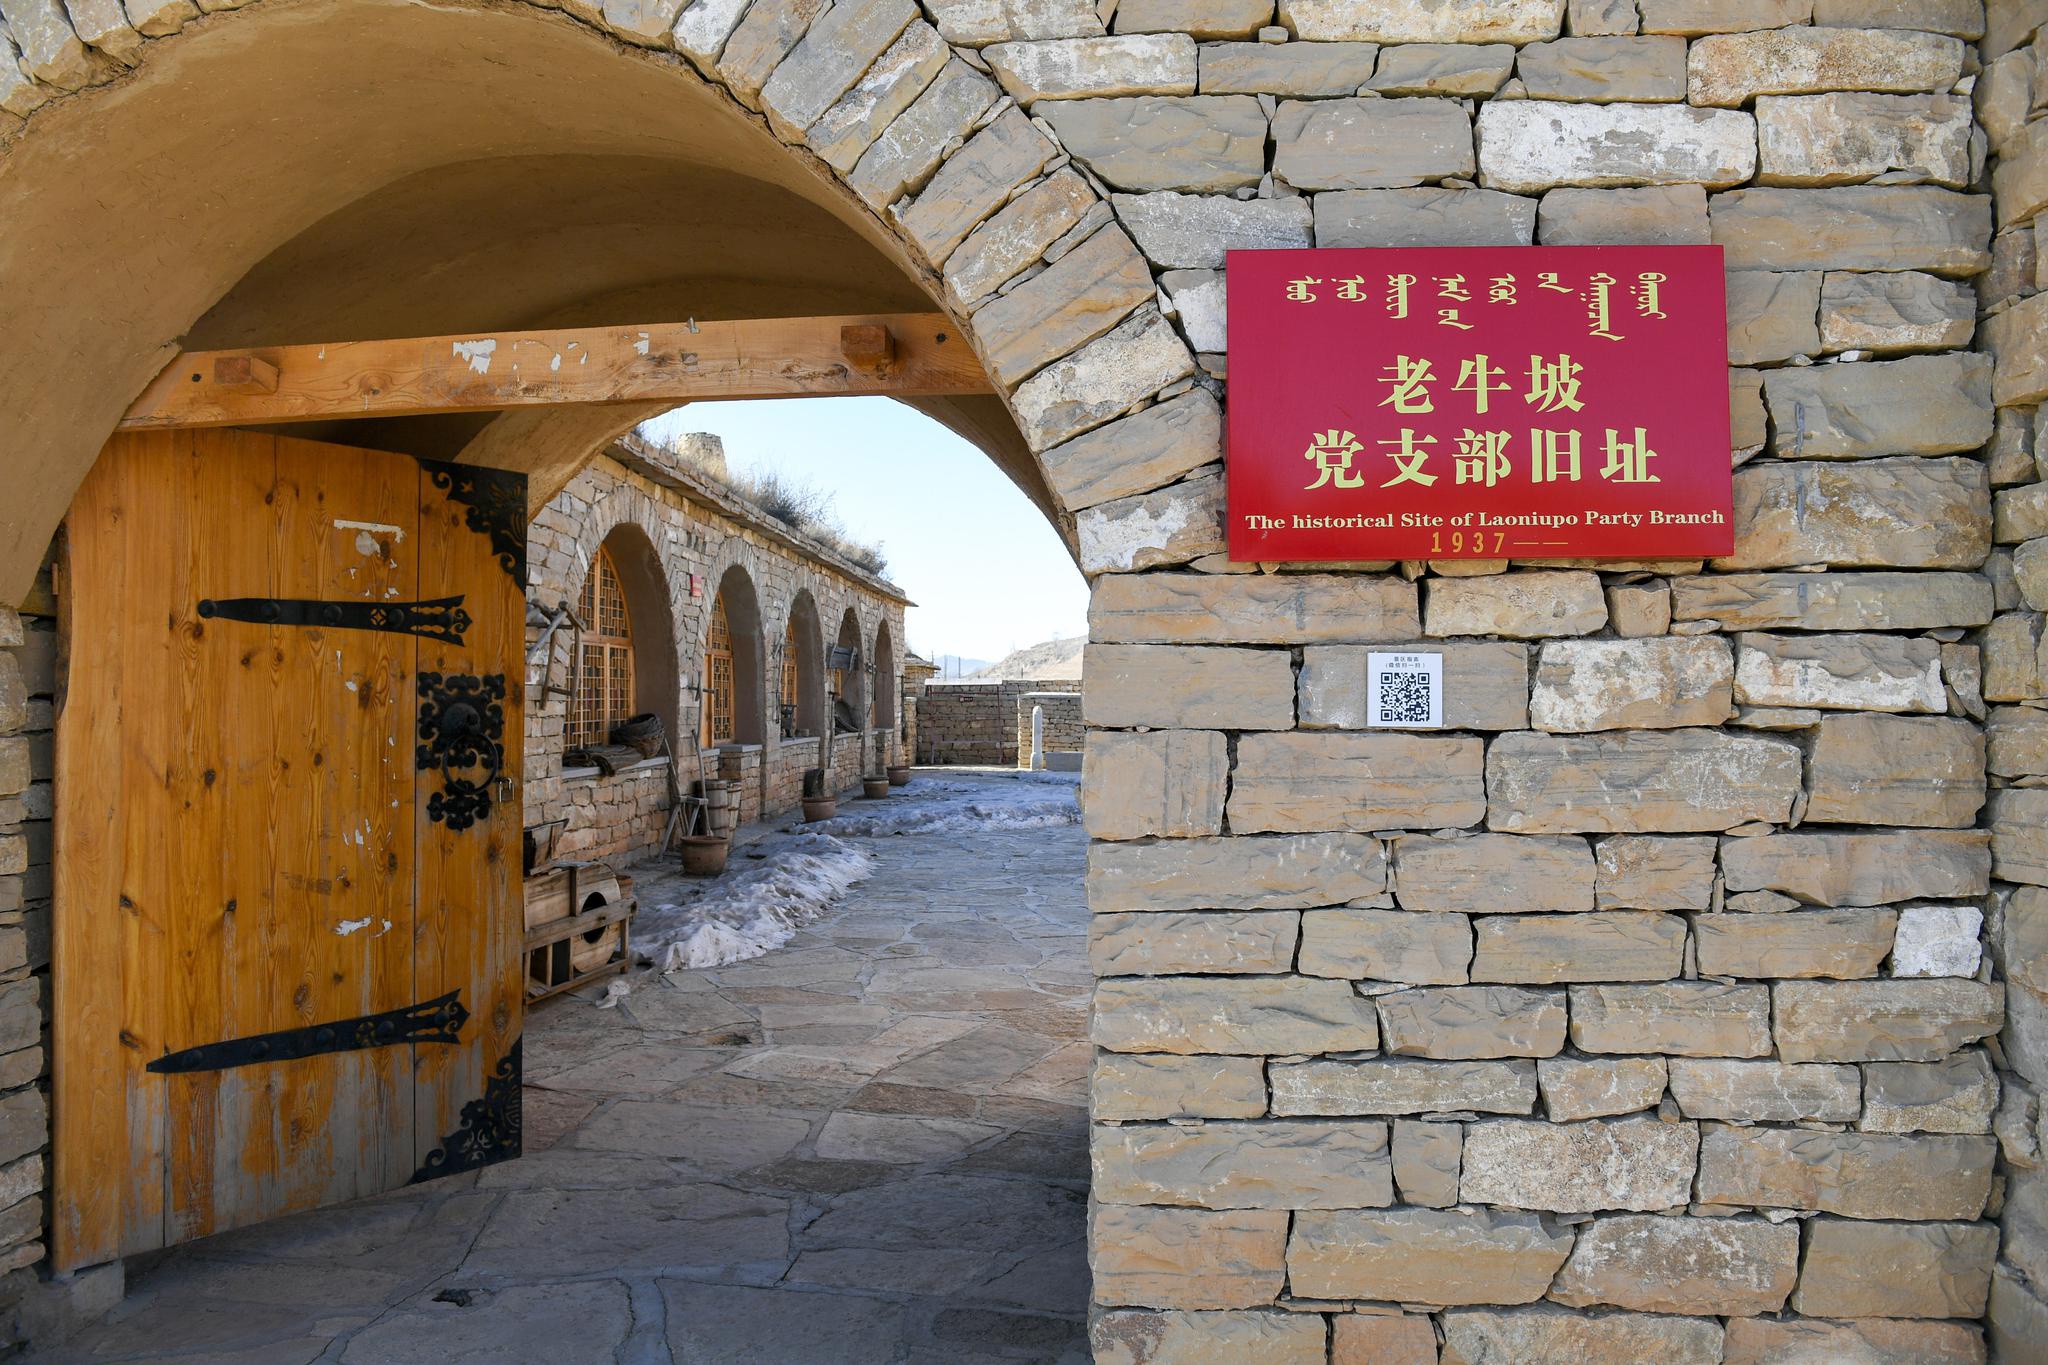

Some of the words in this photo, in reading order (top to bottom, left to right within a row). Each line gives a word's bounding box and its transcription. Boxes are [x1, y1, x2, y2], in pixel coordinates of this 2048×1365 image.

[1376, 353, 1586, 415] 老牛坡
[1303, 426, 1662, 490] 党支部旧址
[1245, 514, 1286, 530] The
[1291, 512, 1394, 529] historical
[1400, 512, 1444, 528] Site
[1450, 512, 1475, 527] of
[1478, 510, 1579, 529] Laoniupo
[1584, 509, 1644, 528] Party
[1649, 509, 1725, 525] Branch
